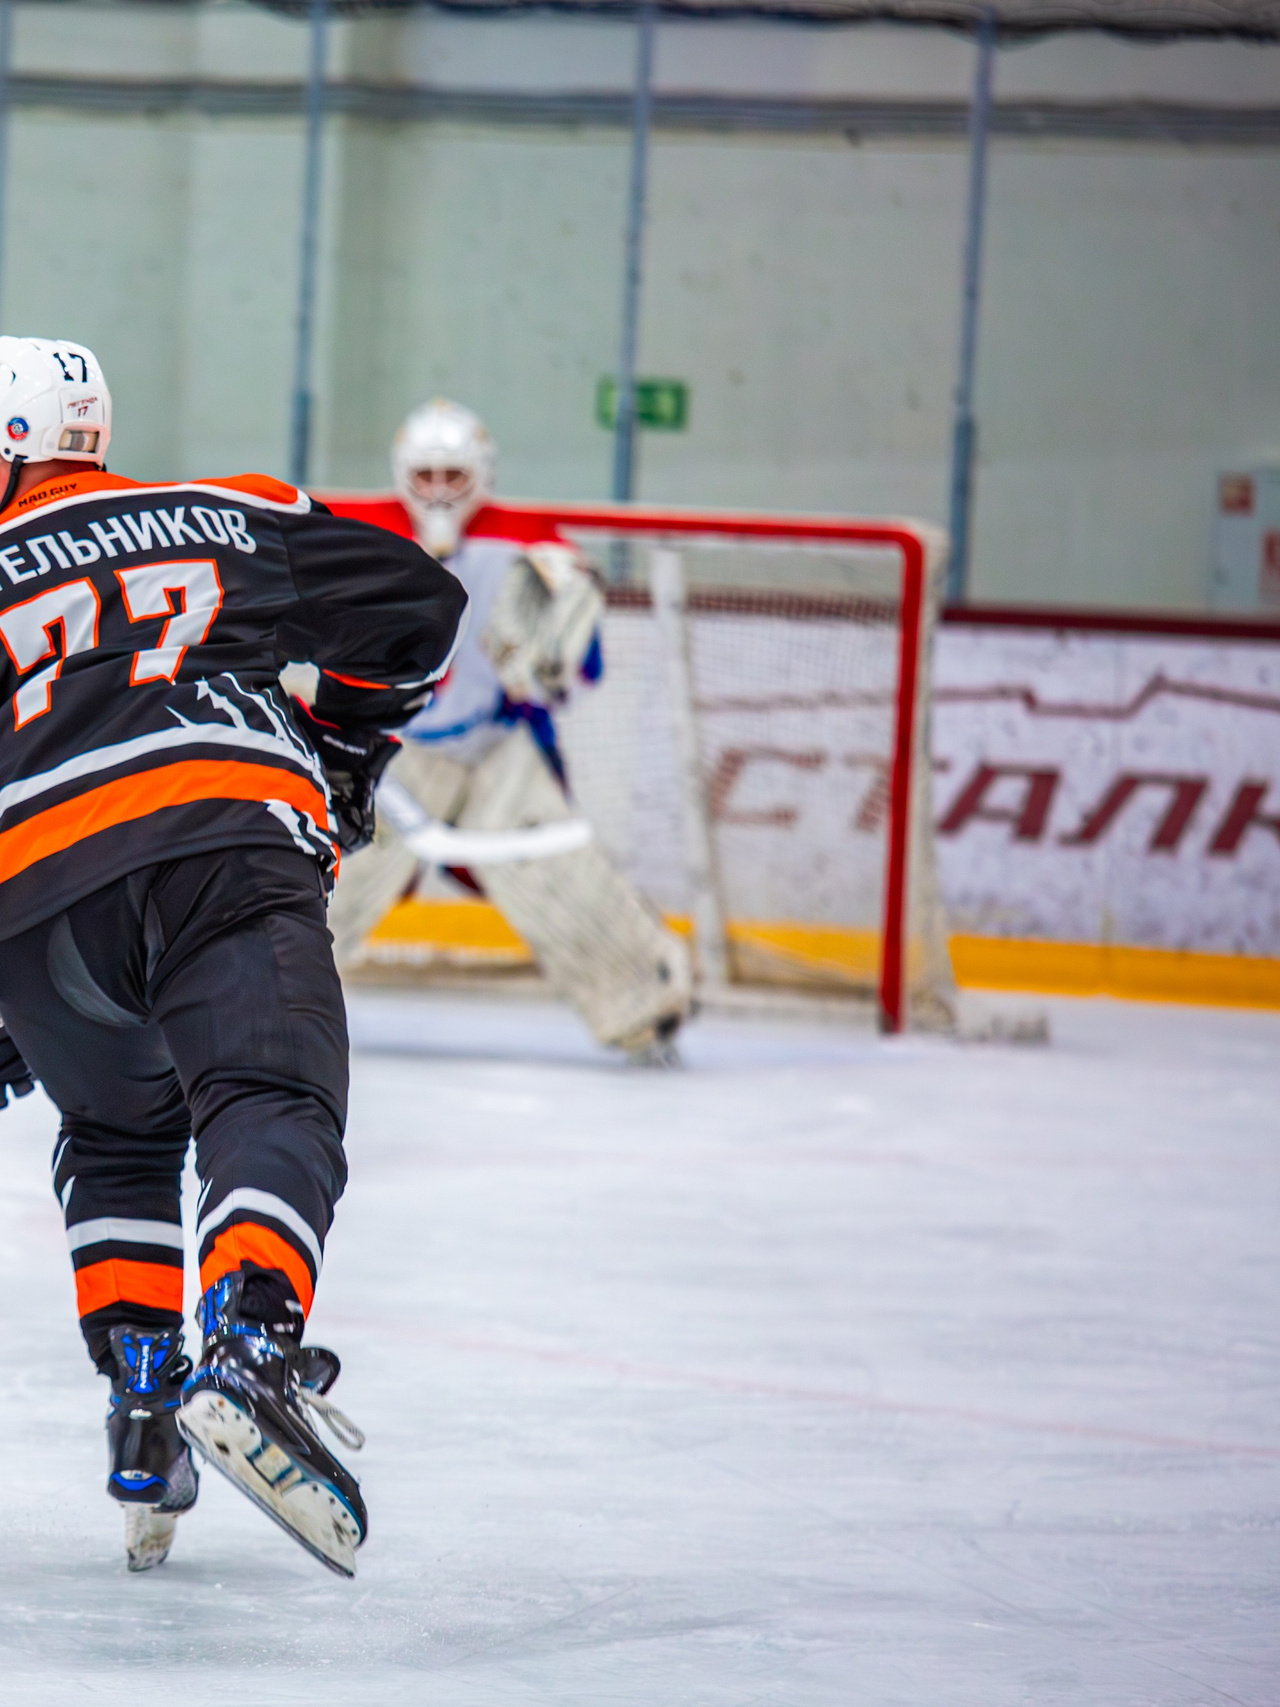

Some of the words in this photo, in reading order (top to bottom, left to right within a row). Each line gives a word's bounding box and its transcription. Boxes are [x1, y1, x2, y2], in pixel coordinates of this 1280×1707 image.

[53, 352, 88, 384] 17
[18, 490, 48, 508] MAD
[49, 483, 78, 497] GUY
